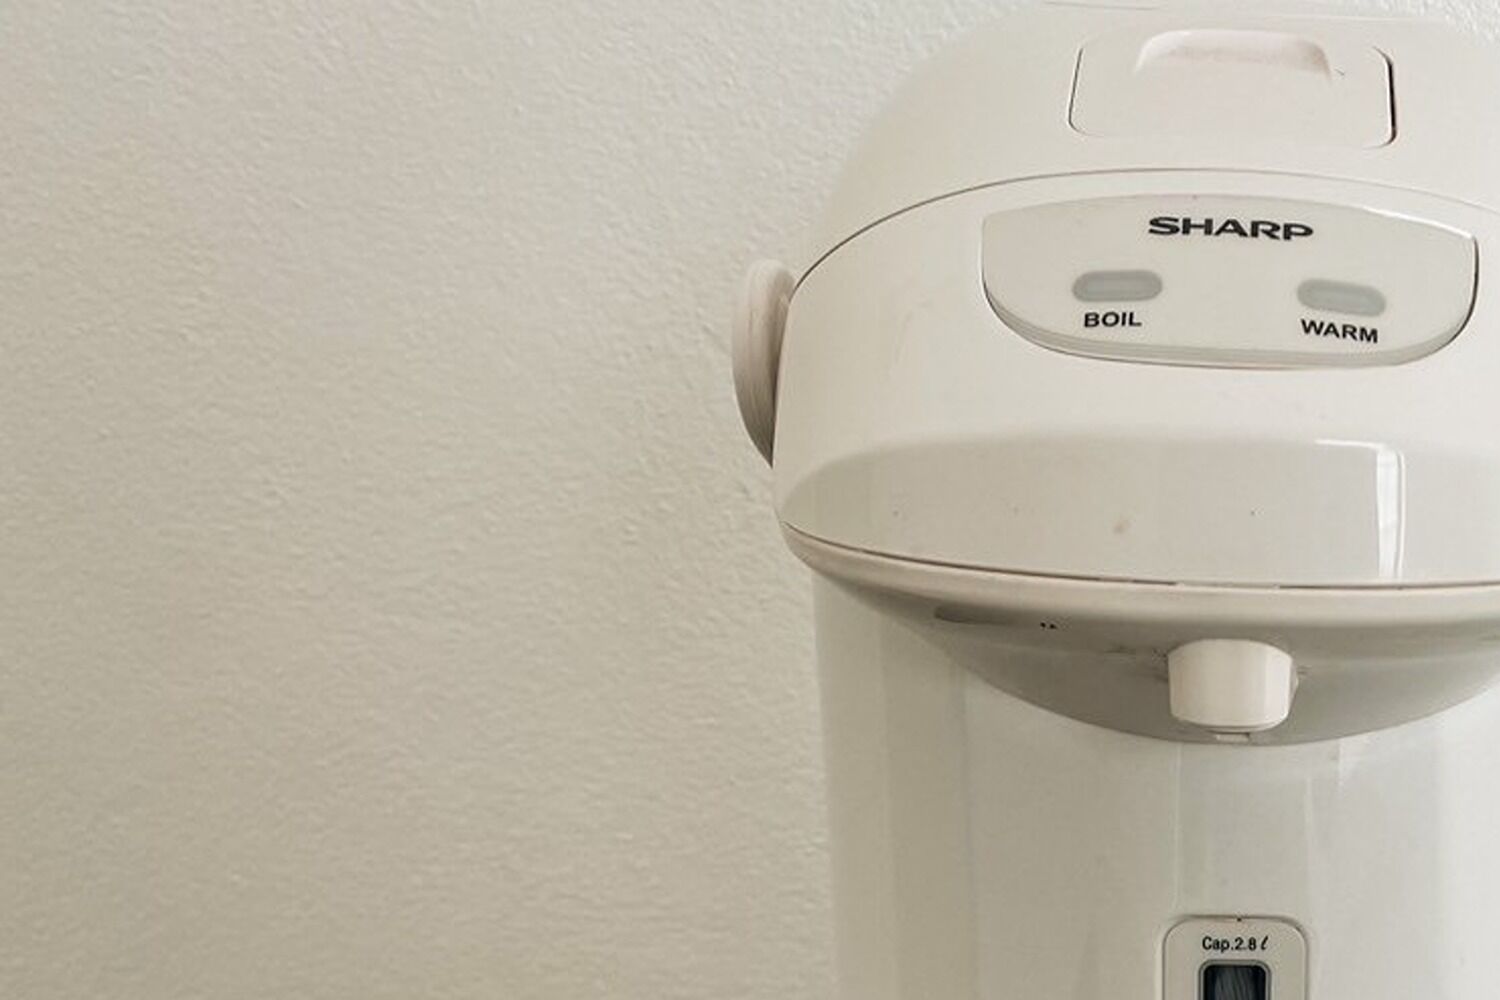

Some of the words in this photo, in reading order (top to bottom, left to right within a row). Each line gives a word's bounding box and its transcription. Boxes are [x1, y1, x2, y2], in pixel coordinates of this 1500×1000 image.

[1148, 216, 1314, 241] SHARP
[1083, 311, 1142, 328] BOIL
[1301, 319, 1380, 344] WARM
